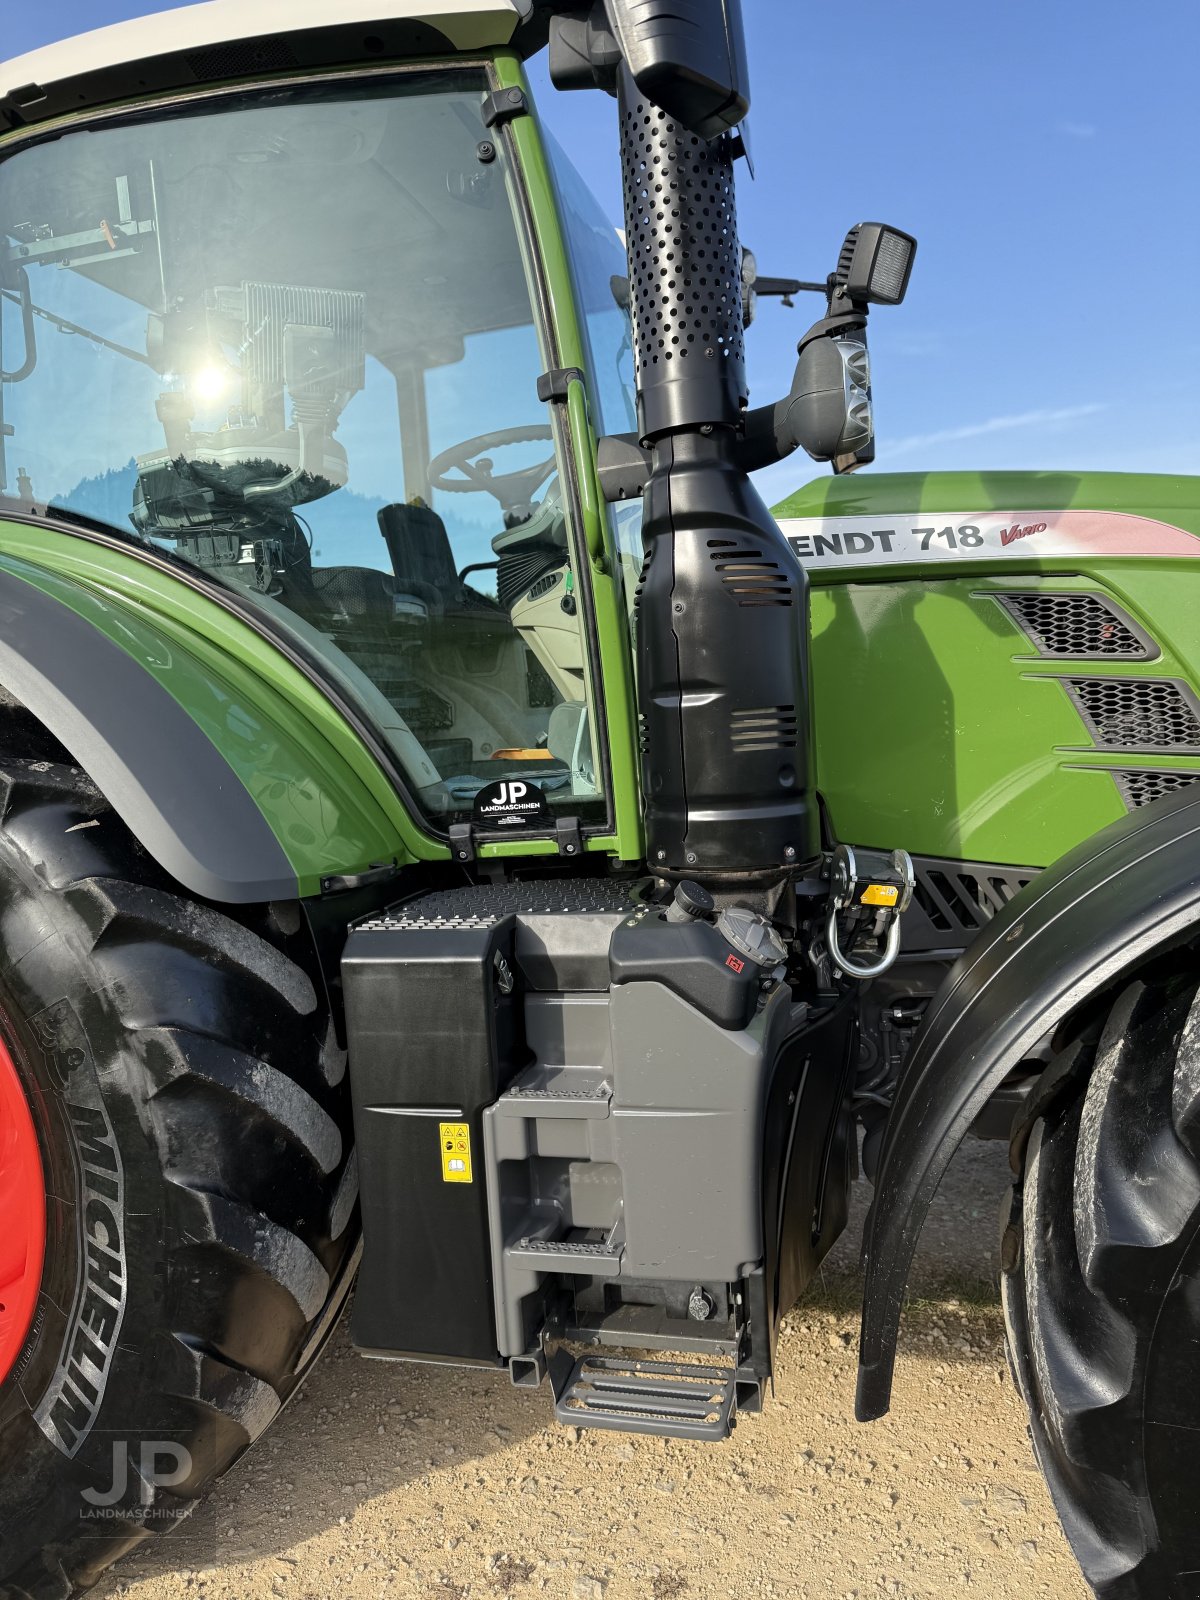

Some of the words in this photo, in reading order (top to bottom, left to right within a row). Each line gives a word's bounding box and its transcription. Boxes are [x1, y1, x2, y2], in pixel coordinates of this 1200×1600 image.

[787, 530, 896, 558] ENDT
[911, 525, 984, 551] 718
[480, 802, 540, 812] LANDMASCHINEN
[491, 782, 527, 805] JP
[49, 1101, 122, 1452] MICHELIN
